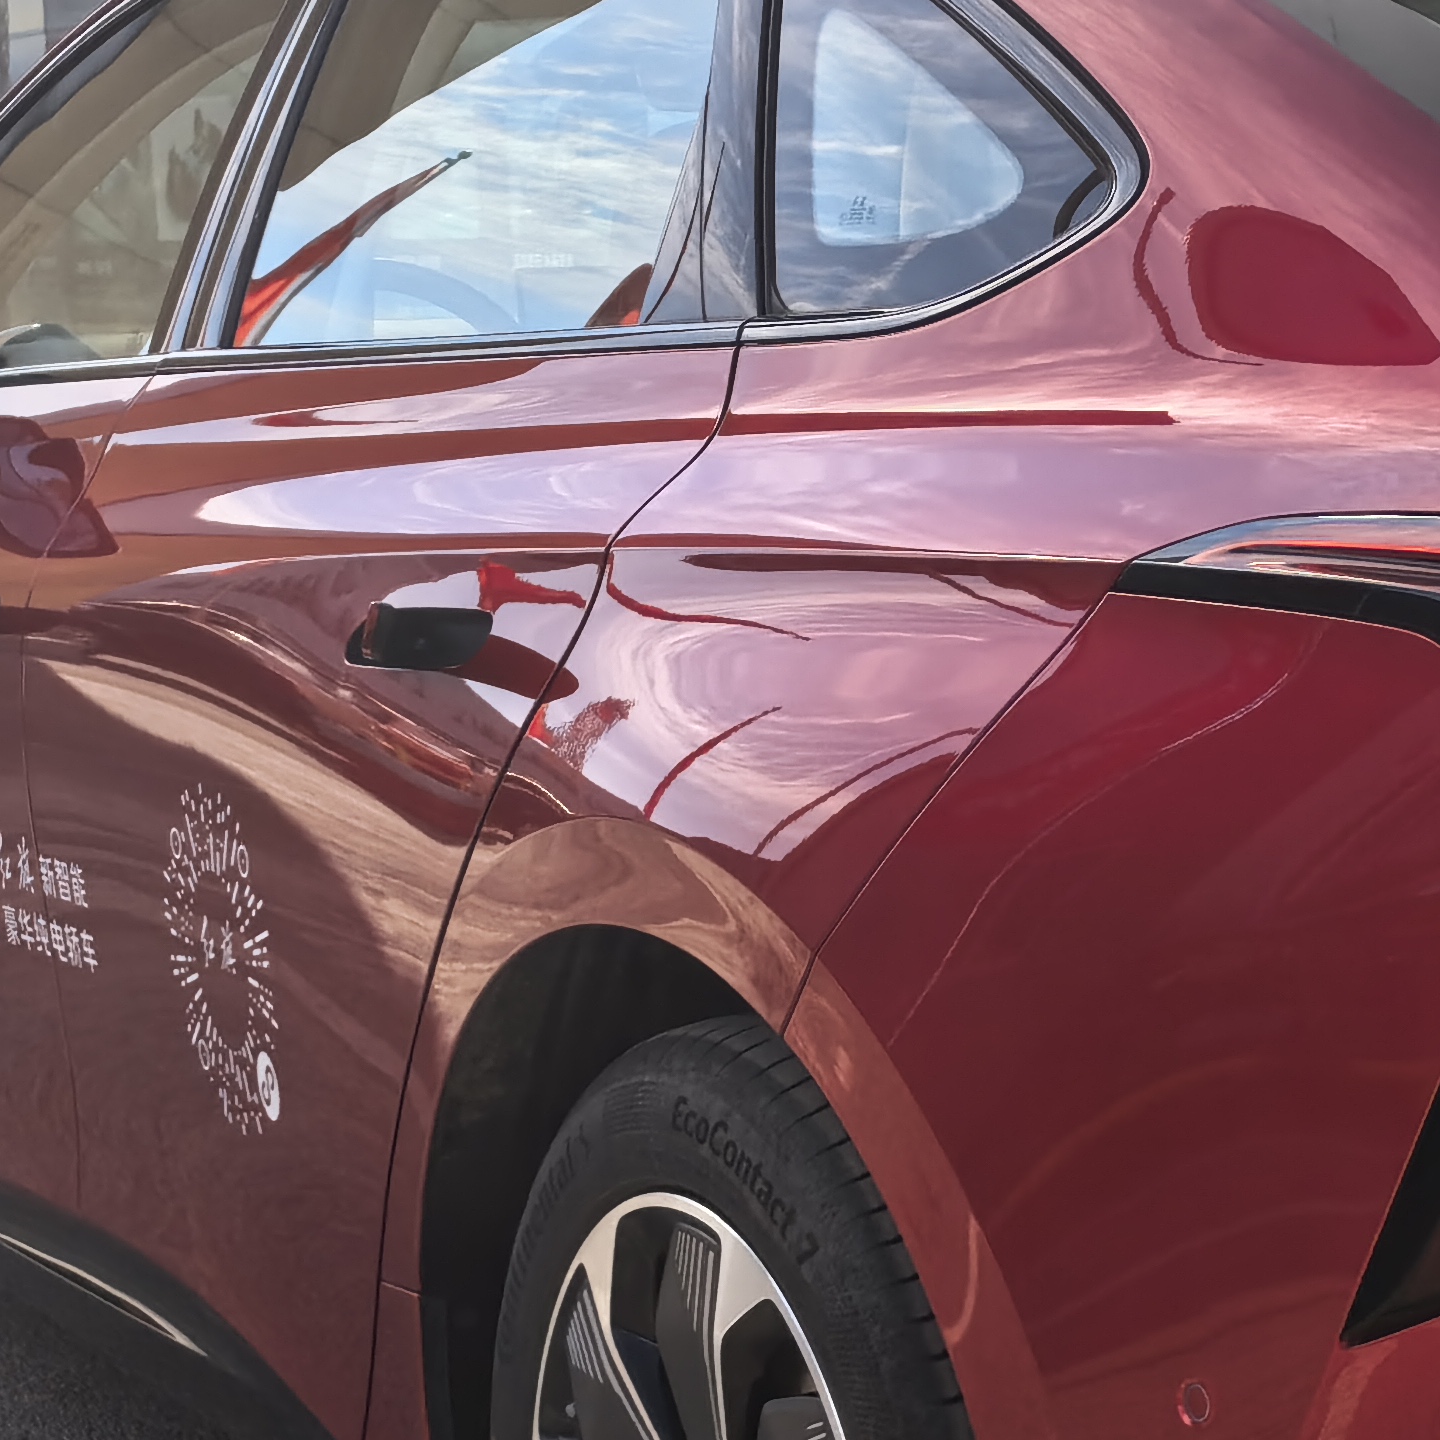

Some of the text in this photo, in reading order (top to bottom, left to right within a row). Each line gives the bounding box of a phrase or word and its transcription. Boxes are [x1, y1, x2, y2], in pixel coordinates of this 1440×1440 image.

[38, 853, 89, 909] 新智能
[1, 903, 100, 974] 豪华纯电轿车
[670, 1094, 800, 1238] EcoContact
